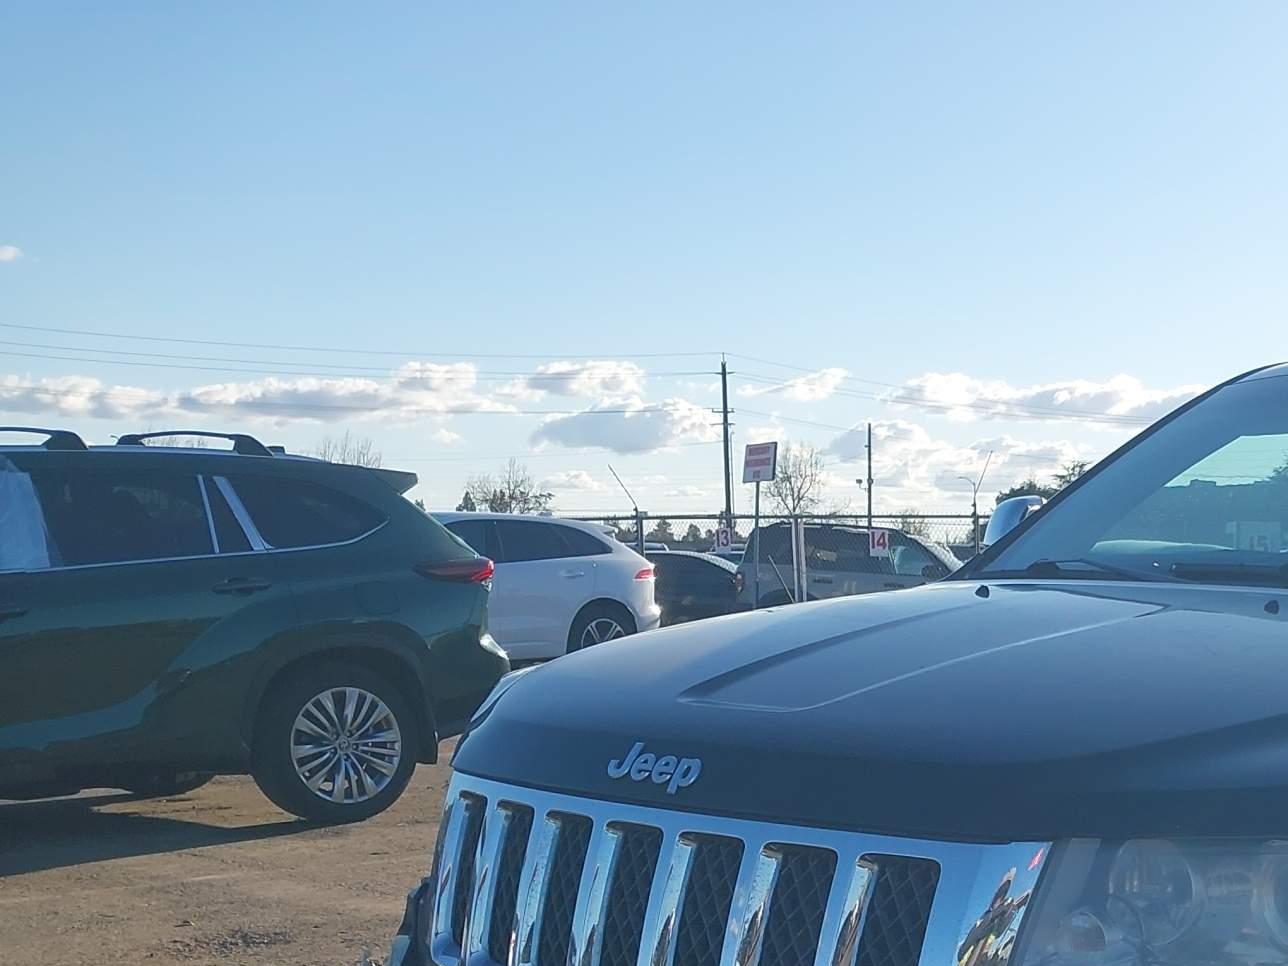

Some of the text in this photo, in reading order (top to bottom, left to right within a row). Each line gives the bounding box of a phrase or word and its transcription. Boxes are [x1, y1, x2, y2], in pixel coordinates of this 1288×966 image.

[715, 530, 731, 548] 13
[870, 531, 888, 550] 14
[607, 742, 702, 795] Jeep
